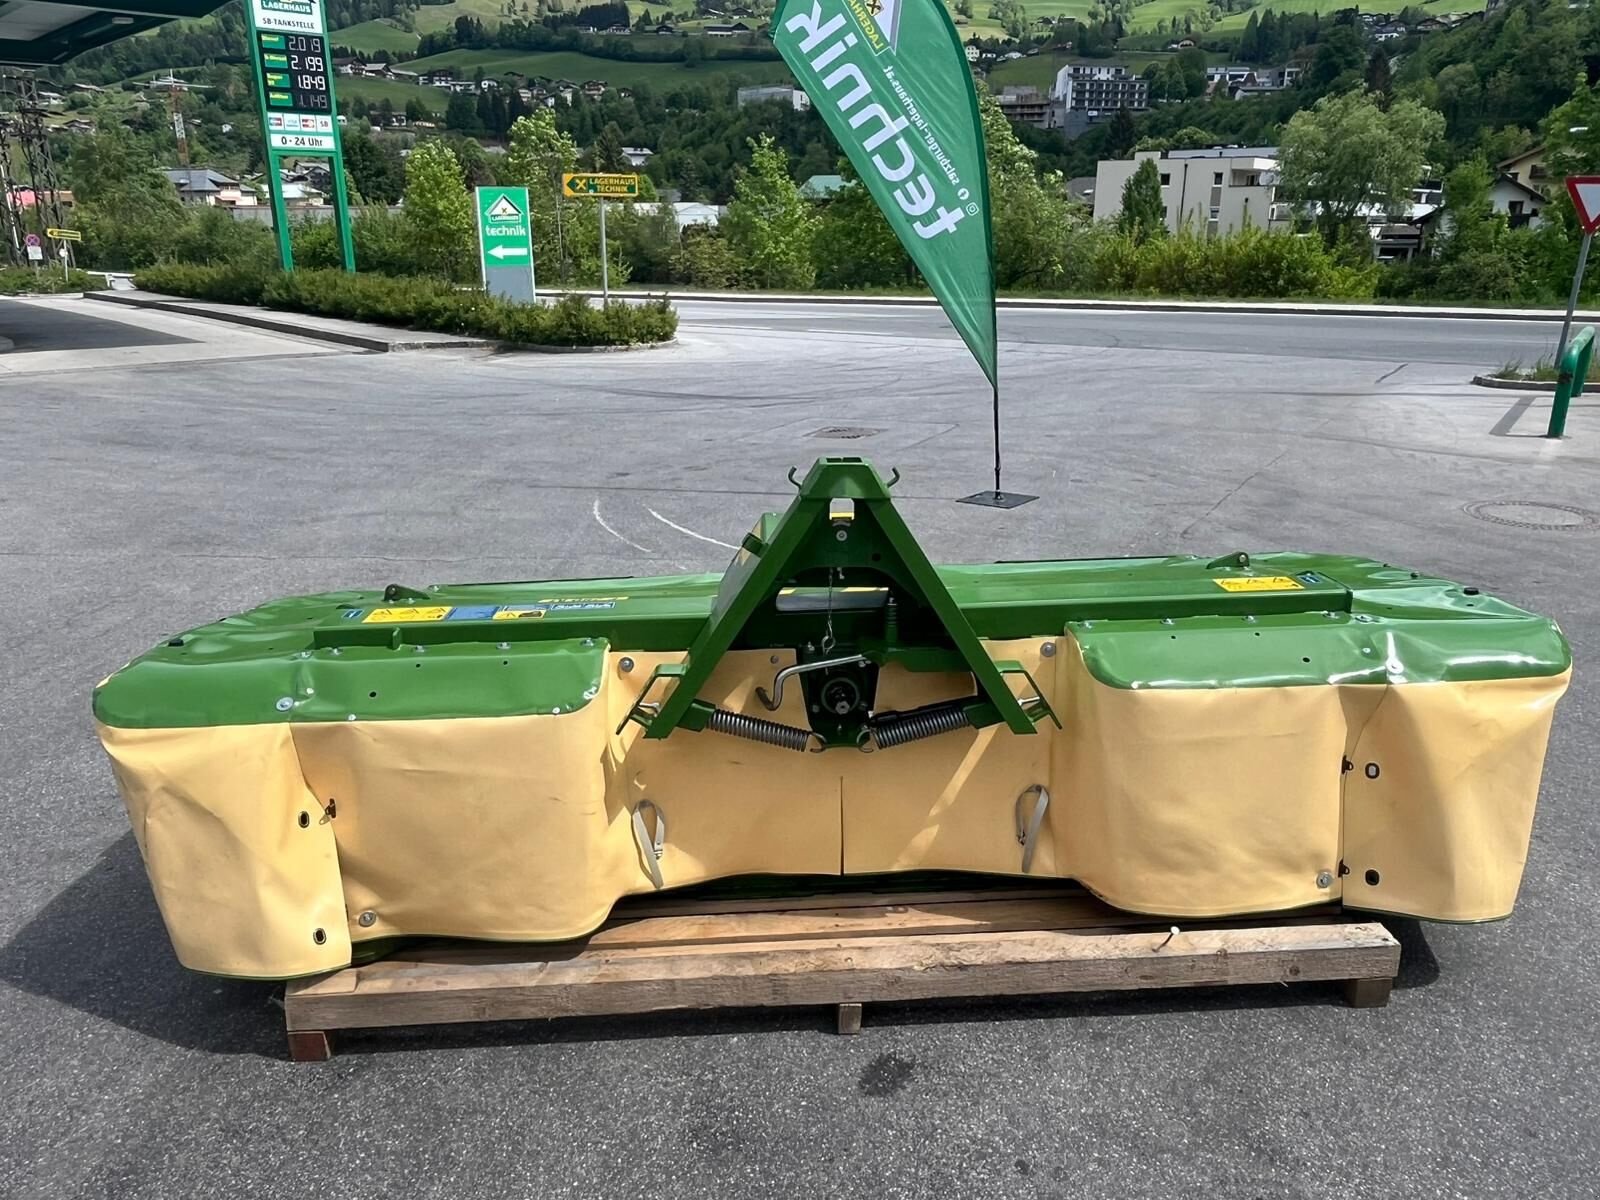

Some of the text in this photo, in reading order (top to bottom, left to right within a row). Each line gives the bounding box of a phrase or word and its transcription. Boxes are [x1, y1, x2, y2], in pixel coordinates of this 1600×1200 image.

[262, 17, 315, 29] SB-TANKSTELLE
[281, 136, 287, 145] 0
[294, 136, 306, 146] 24
[308, 137, 323, 147] Uhr
[485, 225, 526, 236] technik
